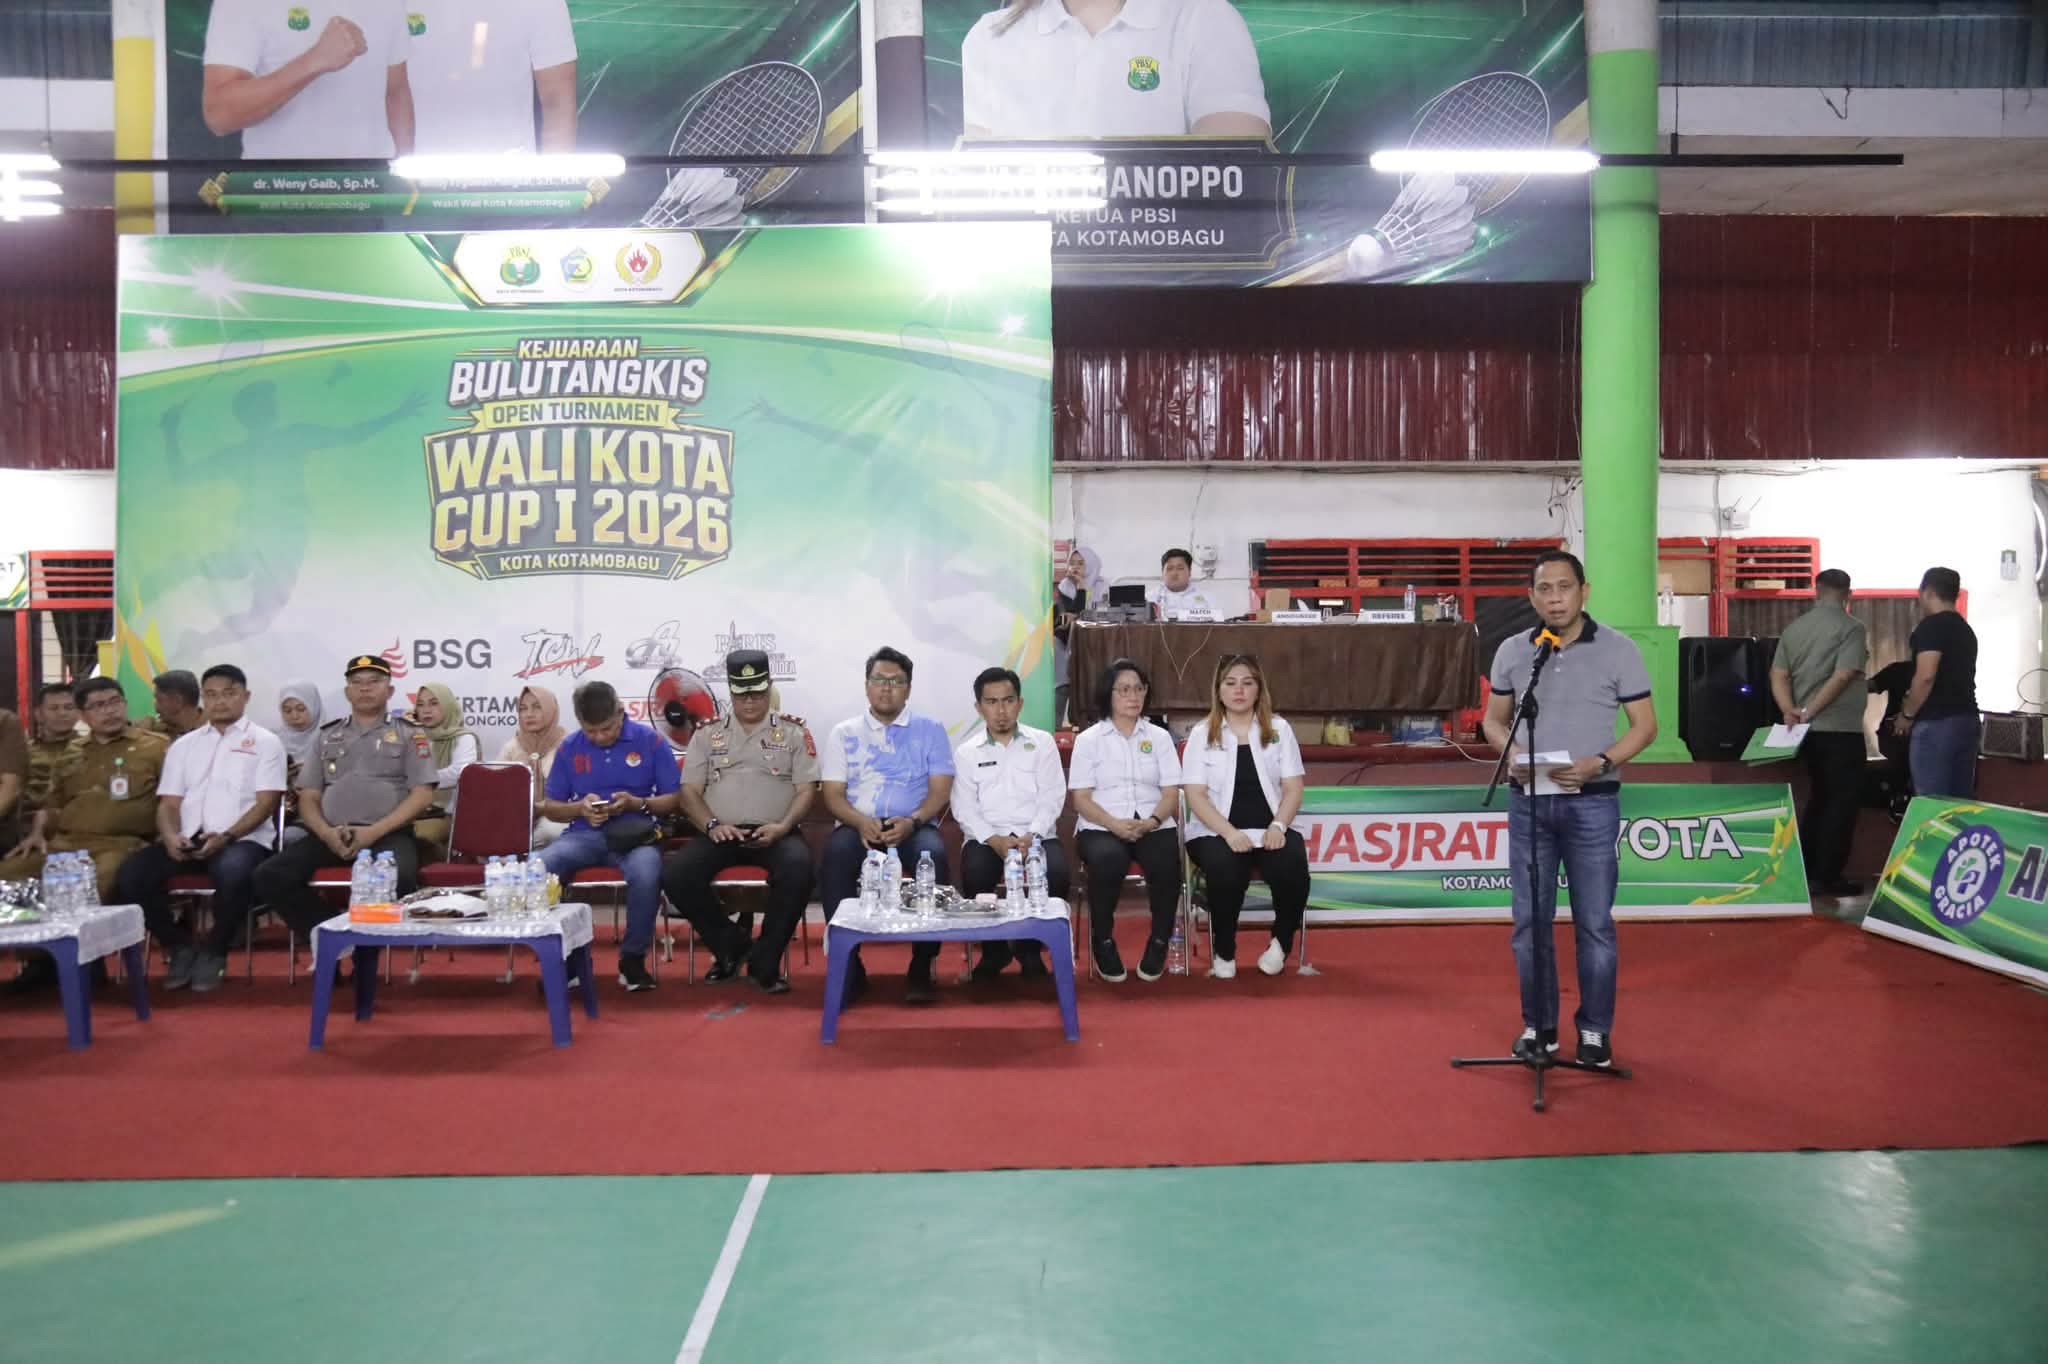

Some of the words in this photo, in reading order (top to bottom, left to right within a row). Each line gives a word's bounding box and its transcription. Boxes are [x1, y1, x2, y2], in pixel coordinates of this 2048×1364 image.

[272, 178, 306, 191] Weny
[1055, 207, 1124, 223] KETUA
[1131, 207, 1177, 223] PBSI
[1077, 229, 1225, 246] KOTAMOBAGU
[518, 339, 639, 359] KEJUARAAN
[449, 358, 708, 405] BULUTANGKIS
[492, 403, 544, 425] OPEN
[550, 401, 660, 422] TURNAMEN
[432, 427, 577, 494] WALI
[590, 427, 730, 495] KOTA
[434, 490, 541, 553] CUP
[593, 488, 730, 554] 2026
[500, 554, 542, 571] KOTA
[547, 553, 660, 571] KOTAMOBAGU
[413, 639, 492, 670] BSG
[464, 715, 518, 726] ONGKO
[1615, 816, 1744, 860] YOTA
[1946, 832, 2001, 871] APOTEK
[1934, 886, 1986, 919] GRACIA
